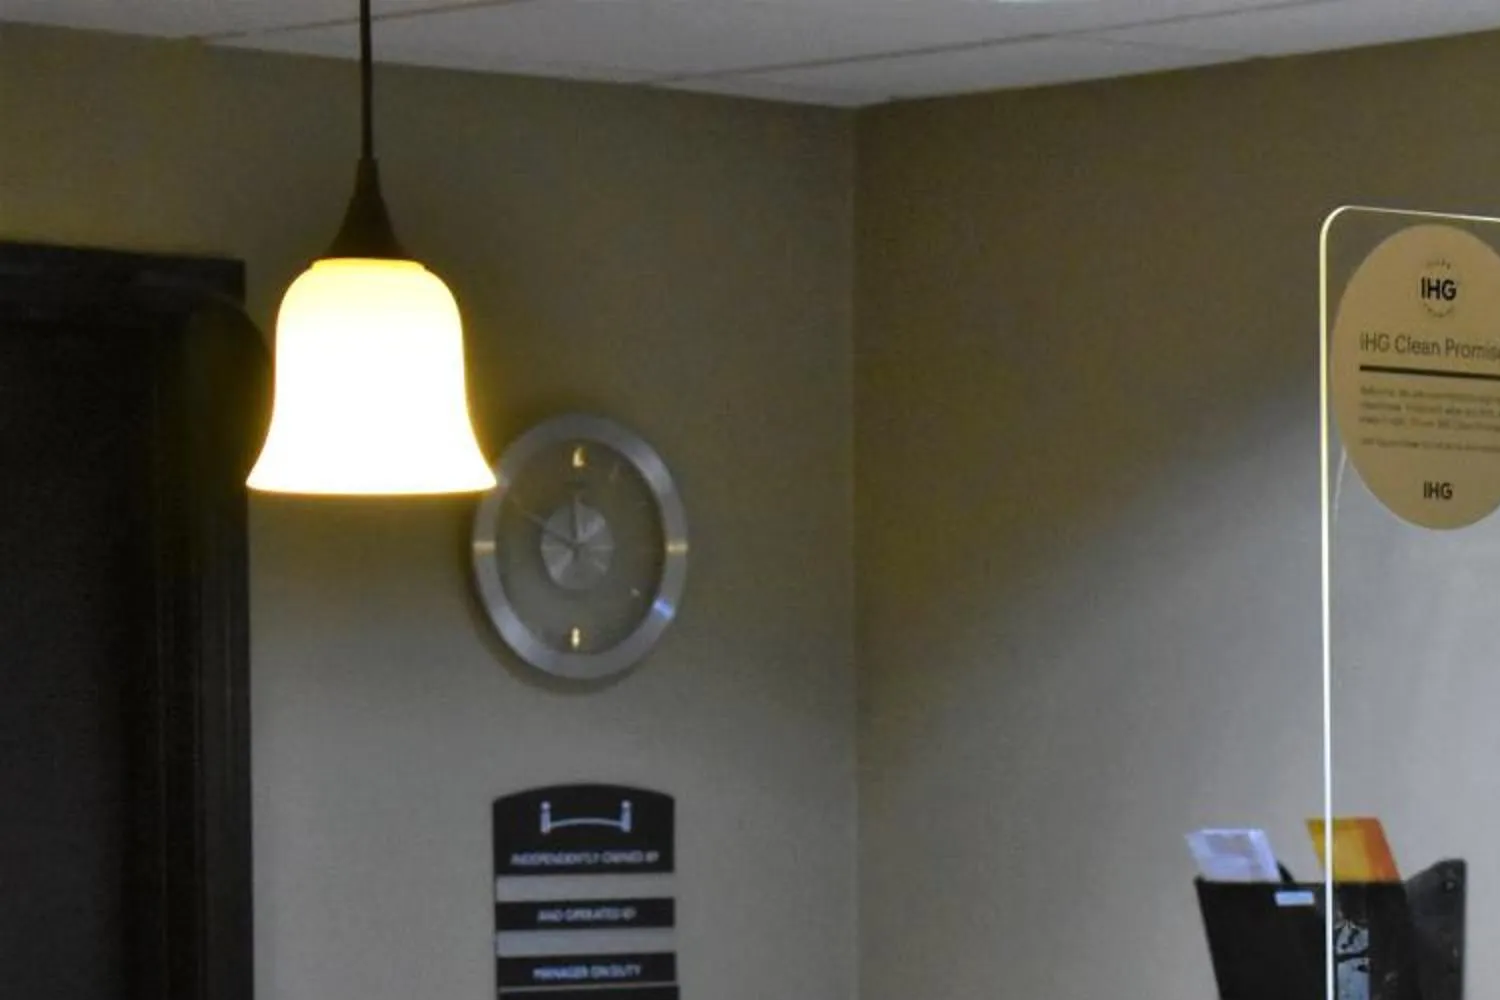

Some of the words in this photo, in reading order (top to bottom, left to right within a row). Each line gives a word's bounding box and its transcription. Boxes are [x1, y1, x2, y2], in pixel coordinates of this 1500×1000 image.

[1420, 276, 1457, 301] IHG
[1359, 331, 1391, 353] IHG
[1394, 333, 1442, 356] Clean
[1423, 480, 1454, 500] IHG
